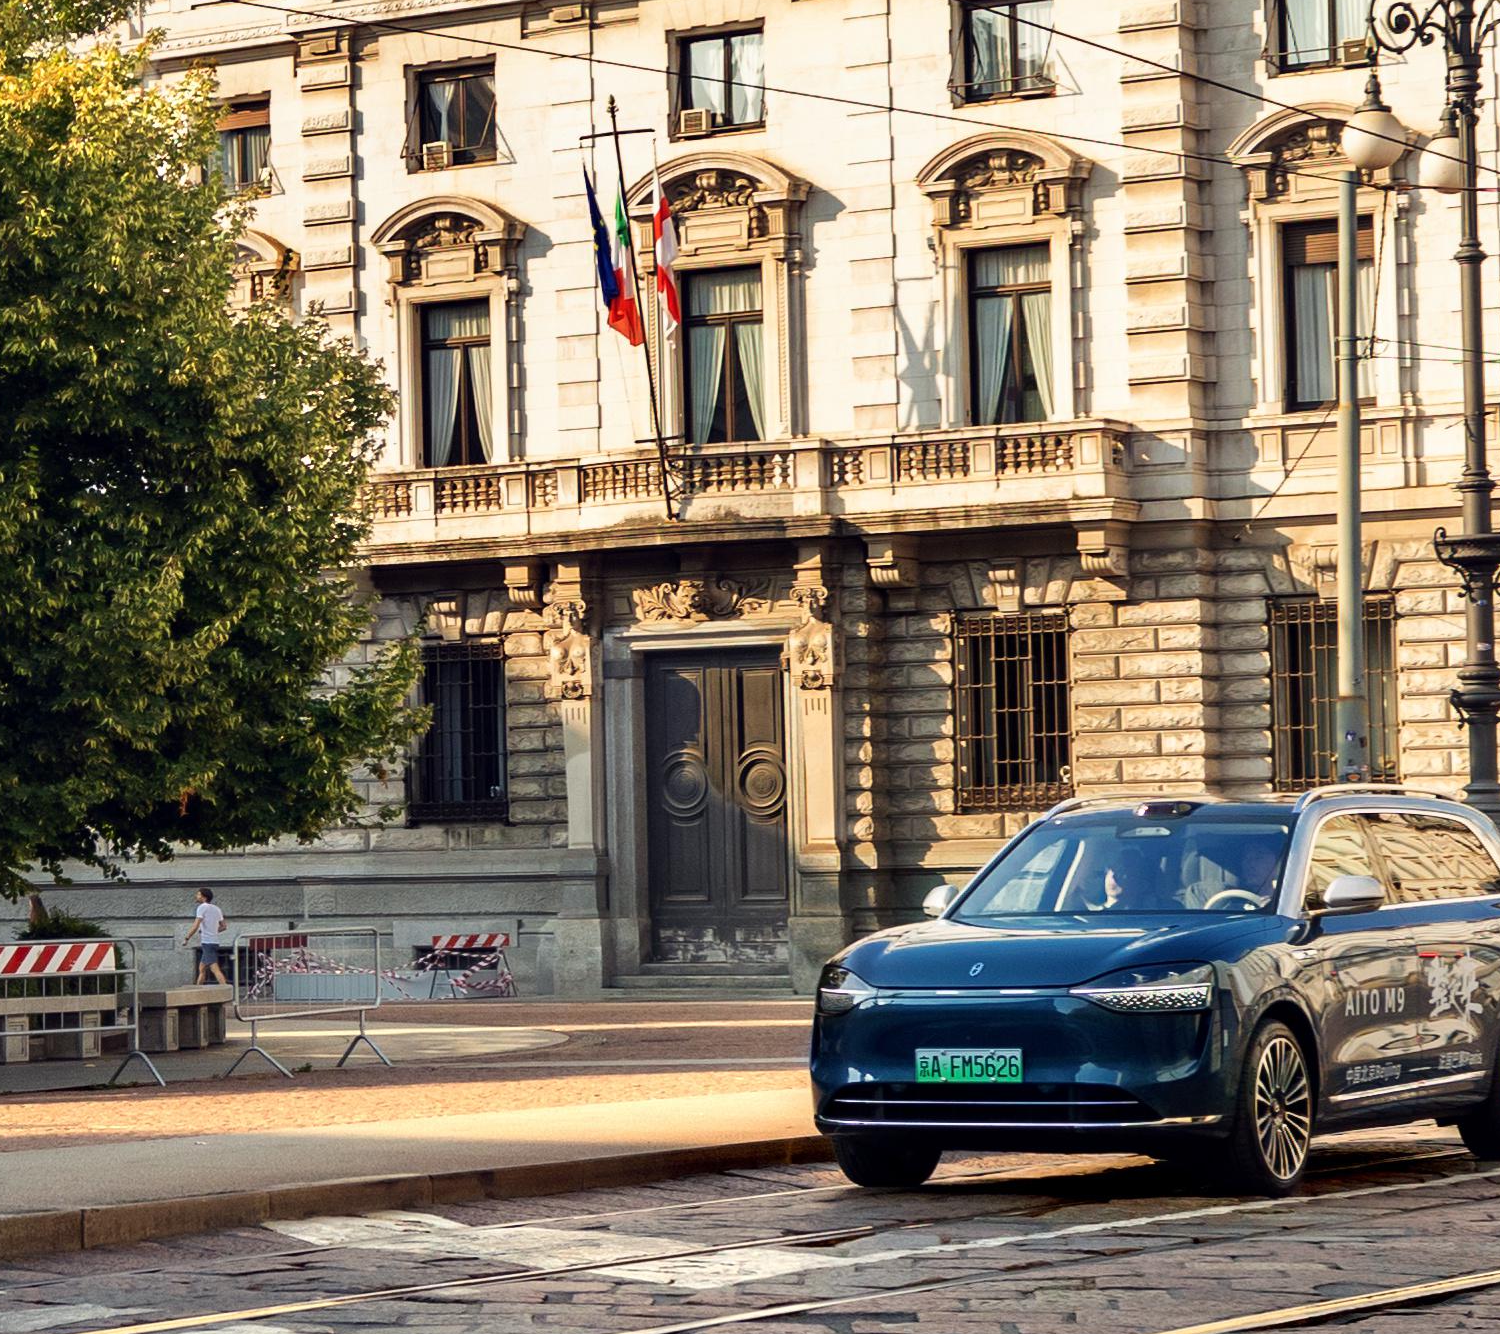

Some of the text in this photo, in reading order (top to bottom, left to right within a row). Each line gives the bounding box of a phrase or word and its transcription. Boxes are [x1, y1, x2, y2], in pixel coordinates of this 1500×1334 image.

[1345, 987, 1405, 1016] AITO M9
[950, 1055, 1020, 1078] FM5626
